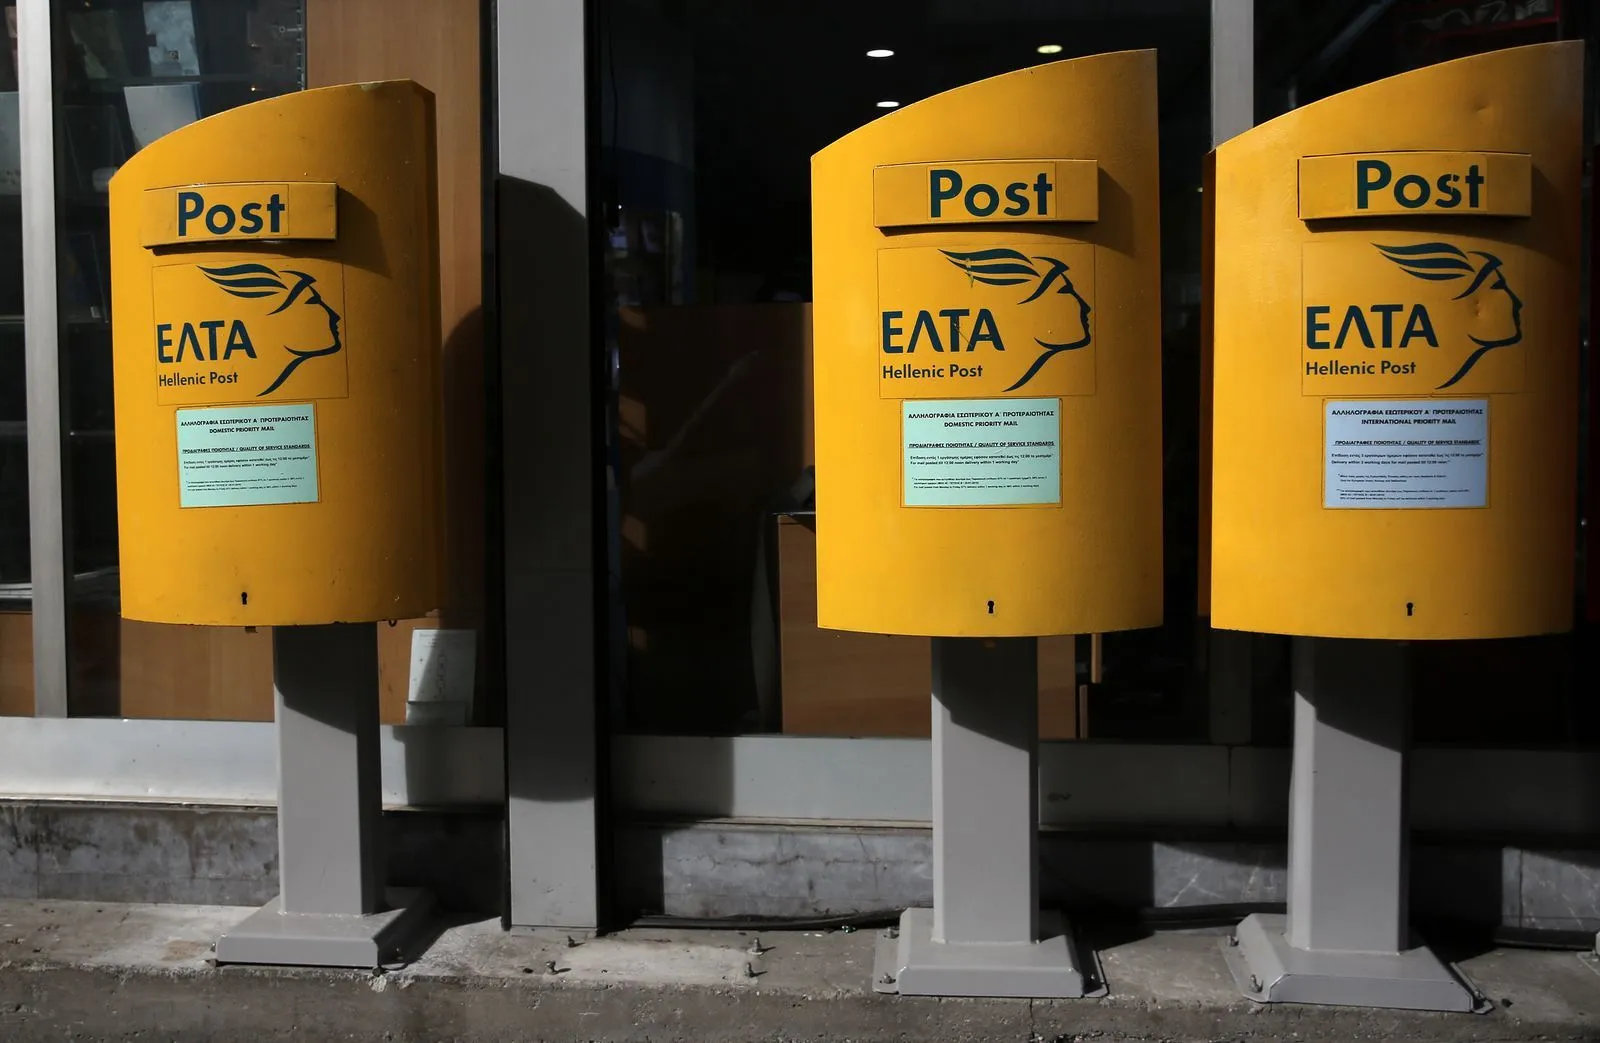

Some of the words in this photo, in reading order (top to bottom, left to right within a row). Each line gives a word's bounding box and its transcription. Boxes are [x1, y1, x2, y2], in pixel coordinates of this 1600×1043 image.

[930, 169, 1053, 218] Post
[1356, 159, 1485, 211] Post
[178, 191, 285, 237] Post
[157, 319, 258, 364] ΕΛΤΑ
[882, 308, 1006, 354] ΕΛΤΑ
[1306, 303, 1439, 350] ΕΛΤΑ
[159, 371, 206, 387] Hellenic
[209, 371, 239, 386] Post
[883, 363, 945, 379] Hellenic
[949, 363, 984, 379] Post
[1306, 359, 1375, 376] Hellenic
[1380, 359, 1417, 376] Post
